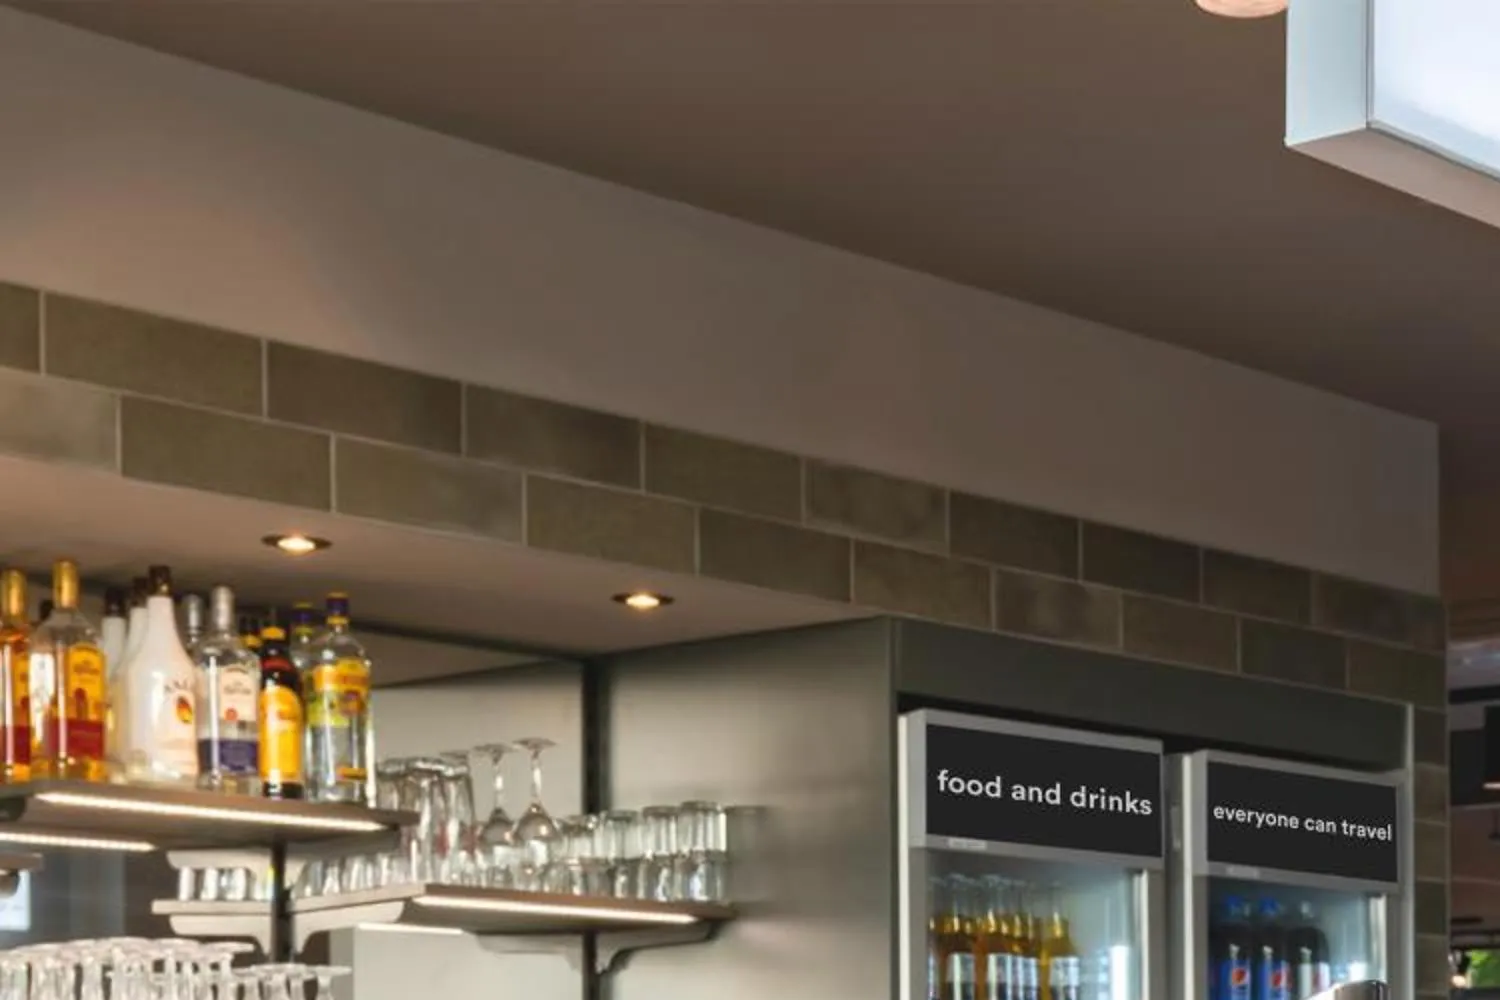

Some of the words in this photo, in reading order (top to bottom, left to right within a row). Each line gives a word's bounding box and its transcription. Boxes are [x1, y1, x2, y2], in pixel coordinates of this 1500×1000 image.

[937, 768, 1002, 799] food
[1011, 782, 1061, 805] and
[1069, 785, 1153, 816] drinks
[1213, 805, 1300, 829] everyone
[1303, 817, 1337, 833] can
[1341, 819, 1393, 841] travel
